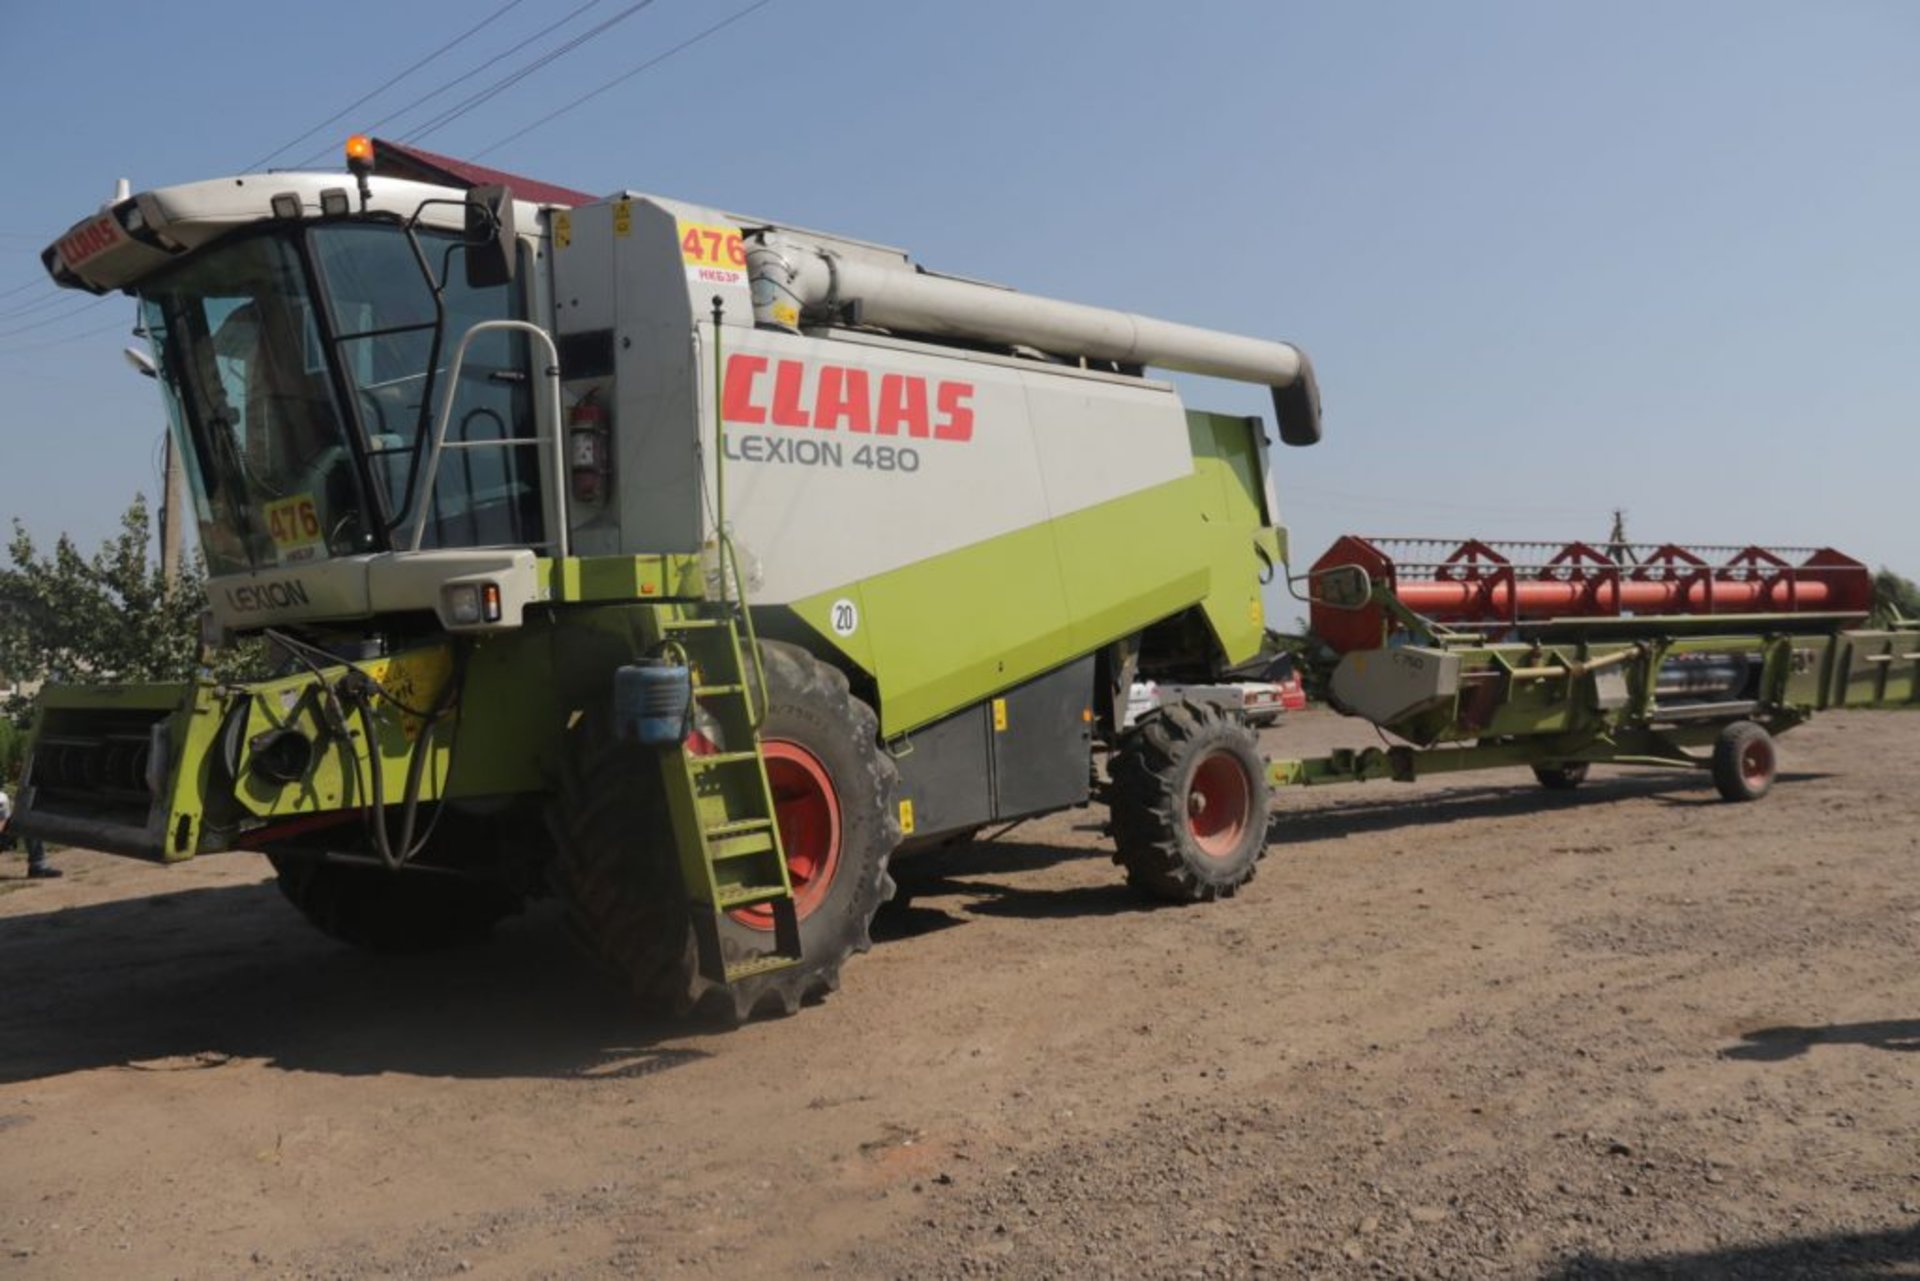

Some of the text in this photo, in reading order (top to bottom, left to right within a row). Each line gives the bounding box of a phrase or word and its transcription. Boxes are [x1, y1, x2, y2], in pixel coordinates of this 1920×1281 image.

[58, 217, 122, 266] CLAAS
[683, 228, 748, 266] 476
[722, 354, 974, 442] CLAAS
[722, 433, 920, 473] LEXION 480
[270, 501, 320, 542] 476
[224, 579, 310, 613] LEXION
[836, 604, 853, 631] 20
